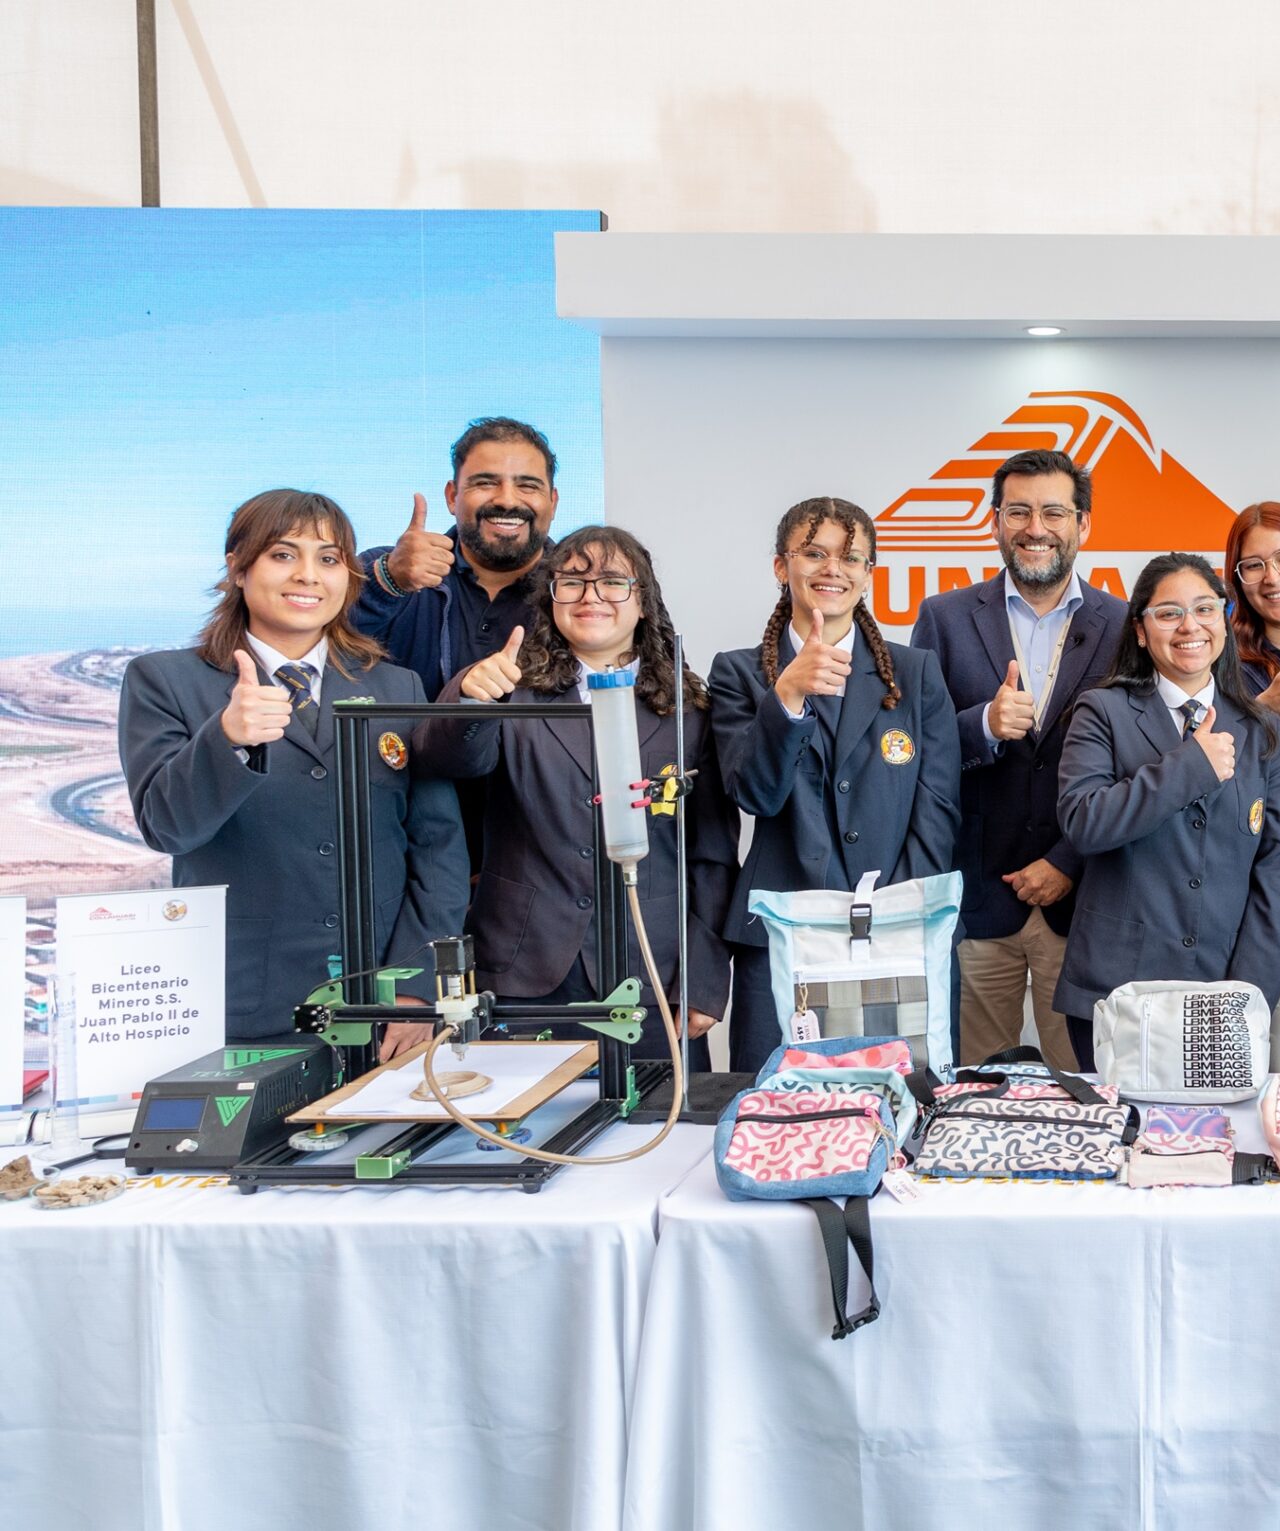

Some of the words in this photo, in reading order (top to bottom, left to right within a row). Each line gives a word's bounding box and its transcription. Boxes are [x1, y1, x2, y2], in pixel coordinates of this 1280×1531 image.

[121, 964, 161, 976] Liceo
[92, 976, 189, 994] Bicentenario
[1184, 991, 1251, 1001] LBMBAGS
[98, 997, 150, 1010] Minero
[155, 993, 181, 1005] S.S.
[1183, 999, 1248, 1009] LBMBAGS
[1183, 1007, 1245, 1017] LBMBAGS
[79, 1017, 117, 1028] Juan
[122, 1011, 163, 1024] Pablo
[182, 1008, 199, 1019] de
[1183, 1016, 1247, 1025] LBMBAGS
[88, 1033, 120, 1044] Alto
[125, 1024, 190, 1040] Hospicio
[1183, 1025, 1249, 1034] LBMBAGS
[1183, 1034, 1251, 1043] LBMBAGS
[1183, 1042, 1251, 1052] LBMBAGS
[1183, 1051, 1252, 1061] LBMBAGS
[1183, 1061, 1253, 1070] LBMBAGS
[1184, 1070, 1253, 1079] LBMBAGS
[1184, 1079, 1253, 1088] LBMBAGS
